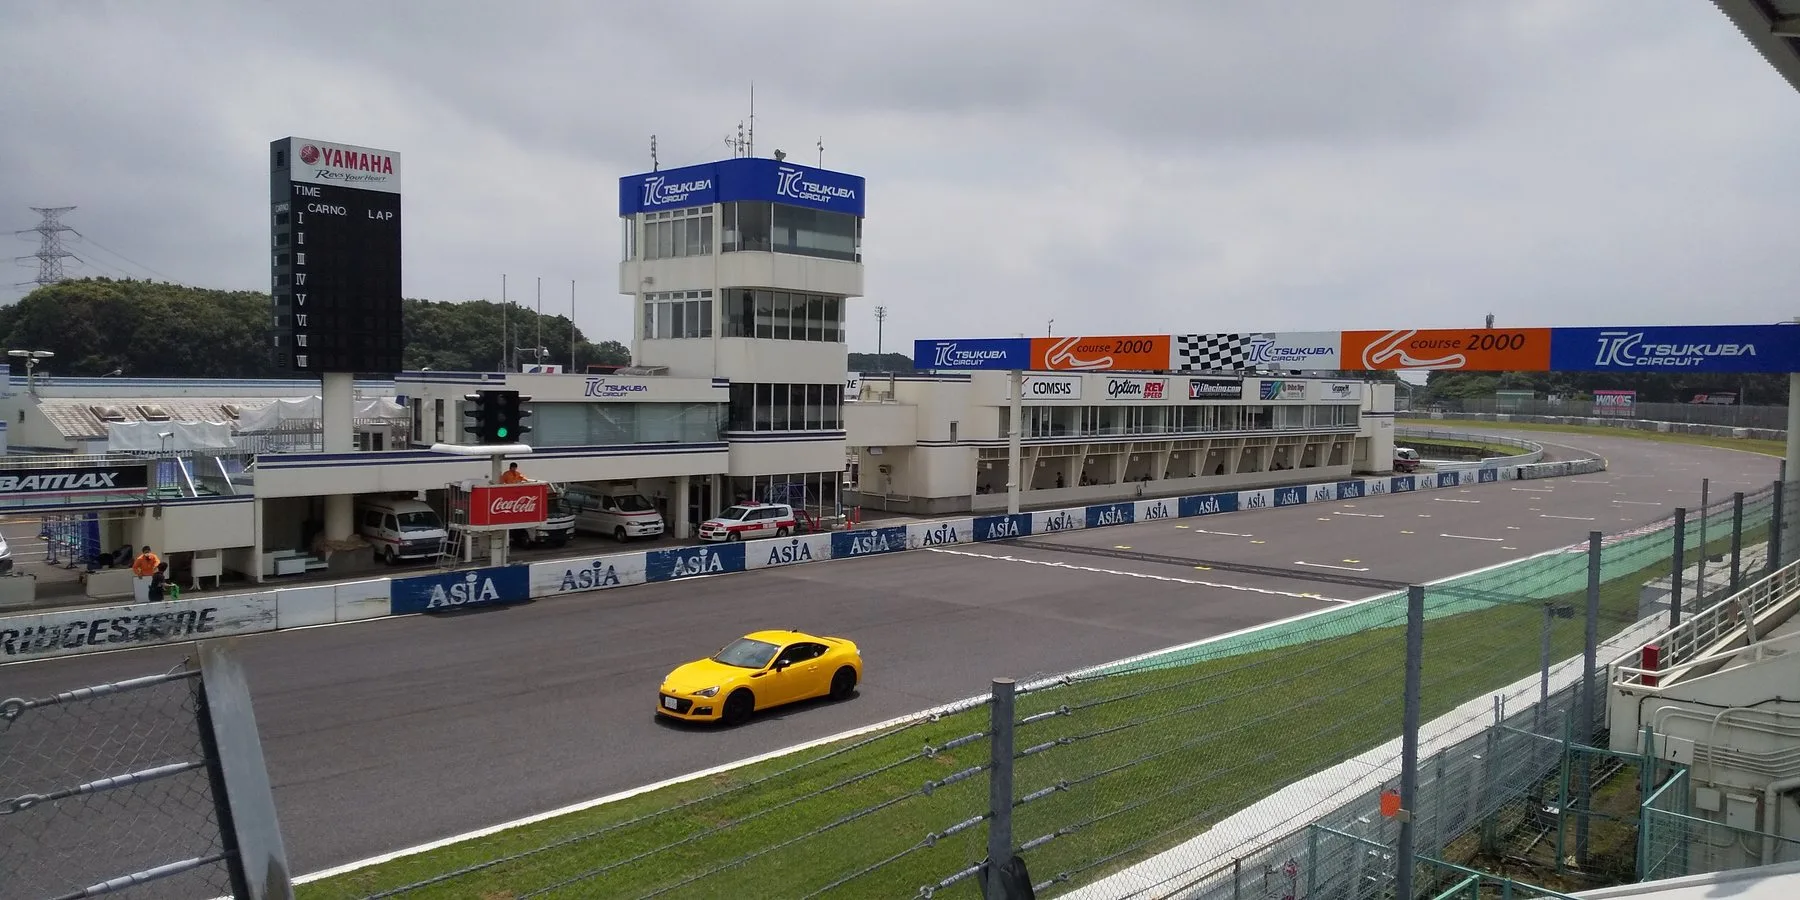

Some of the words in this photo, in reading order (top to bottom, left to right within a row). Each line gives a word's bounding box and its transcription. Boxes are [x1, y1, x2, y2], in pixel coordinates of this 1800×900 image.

[322, 148, 393, 174] YAMAHA
[315, 170, 344, 179] Revs
[344, 174, 364, 182] Your
[294, 185, 320, 198] TIME
[664, 179, 712, 195] TSUKUBA
[802, 182, 855, 200] TSUKUBA
[662, 194, 688, 204] CIRCUIT
[799, 192, 831, 203] CIRCUIT
[368, 209, 392, 220] LAP
[296, 294, 306, 306] V
[1076, 343, 1111, 354] course
[1113, 340, 1153, 354] 2000
[1410, 338, 1461, 350] course
[1467, 333, 1524, 350] 2000
[1641, 344, 1756, 356] TSUKUBA
[955, 350, 1007, 360] TSUKUBA
[1274, 347, 1334, 356] TSUKUBA
[1636, 356, 1704, 366] CIRCUIT
[1033, 382, 1071, 395] COMSYS
[1108, 380, 1141, 398] Option
[1144, 382, 1164, 392] REV
[0, 472, 120, 491] BATTLAX
[1371, 481, 1385, 494] ASIA
[1282, 488, 1299, 504] ASIA
[1314, 486, 1330, 500] ASIA
[1343, 483, 1358, 498] ASIA
[490, 496, 539, 514] Coca-Cola
[1199, 496, 1220, 514] ASIA
[1247, 492, 1266, 509] ASIA
[1098, 506, 1123, 526] ASIA
[1145, 502, 1168, 520] ASIA
[986, 517, 1020, 539] ASIA
[1045, 512, 1074, 532] ASIA
[923, 522, 958, 546] ASIA
[850, 531, 890, 555] ASIA
[766, 539, 812, 566] ASIA
[670, 549, 724, 578] ASIA
[559, 561, 620, 592] ASIA
[426, 571, 500, 609] ASIA
[0, 607, 218, 655] RIDGESTONE
